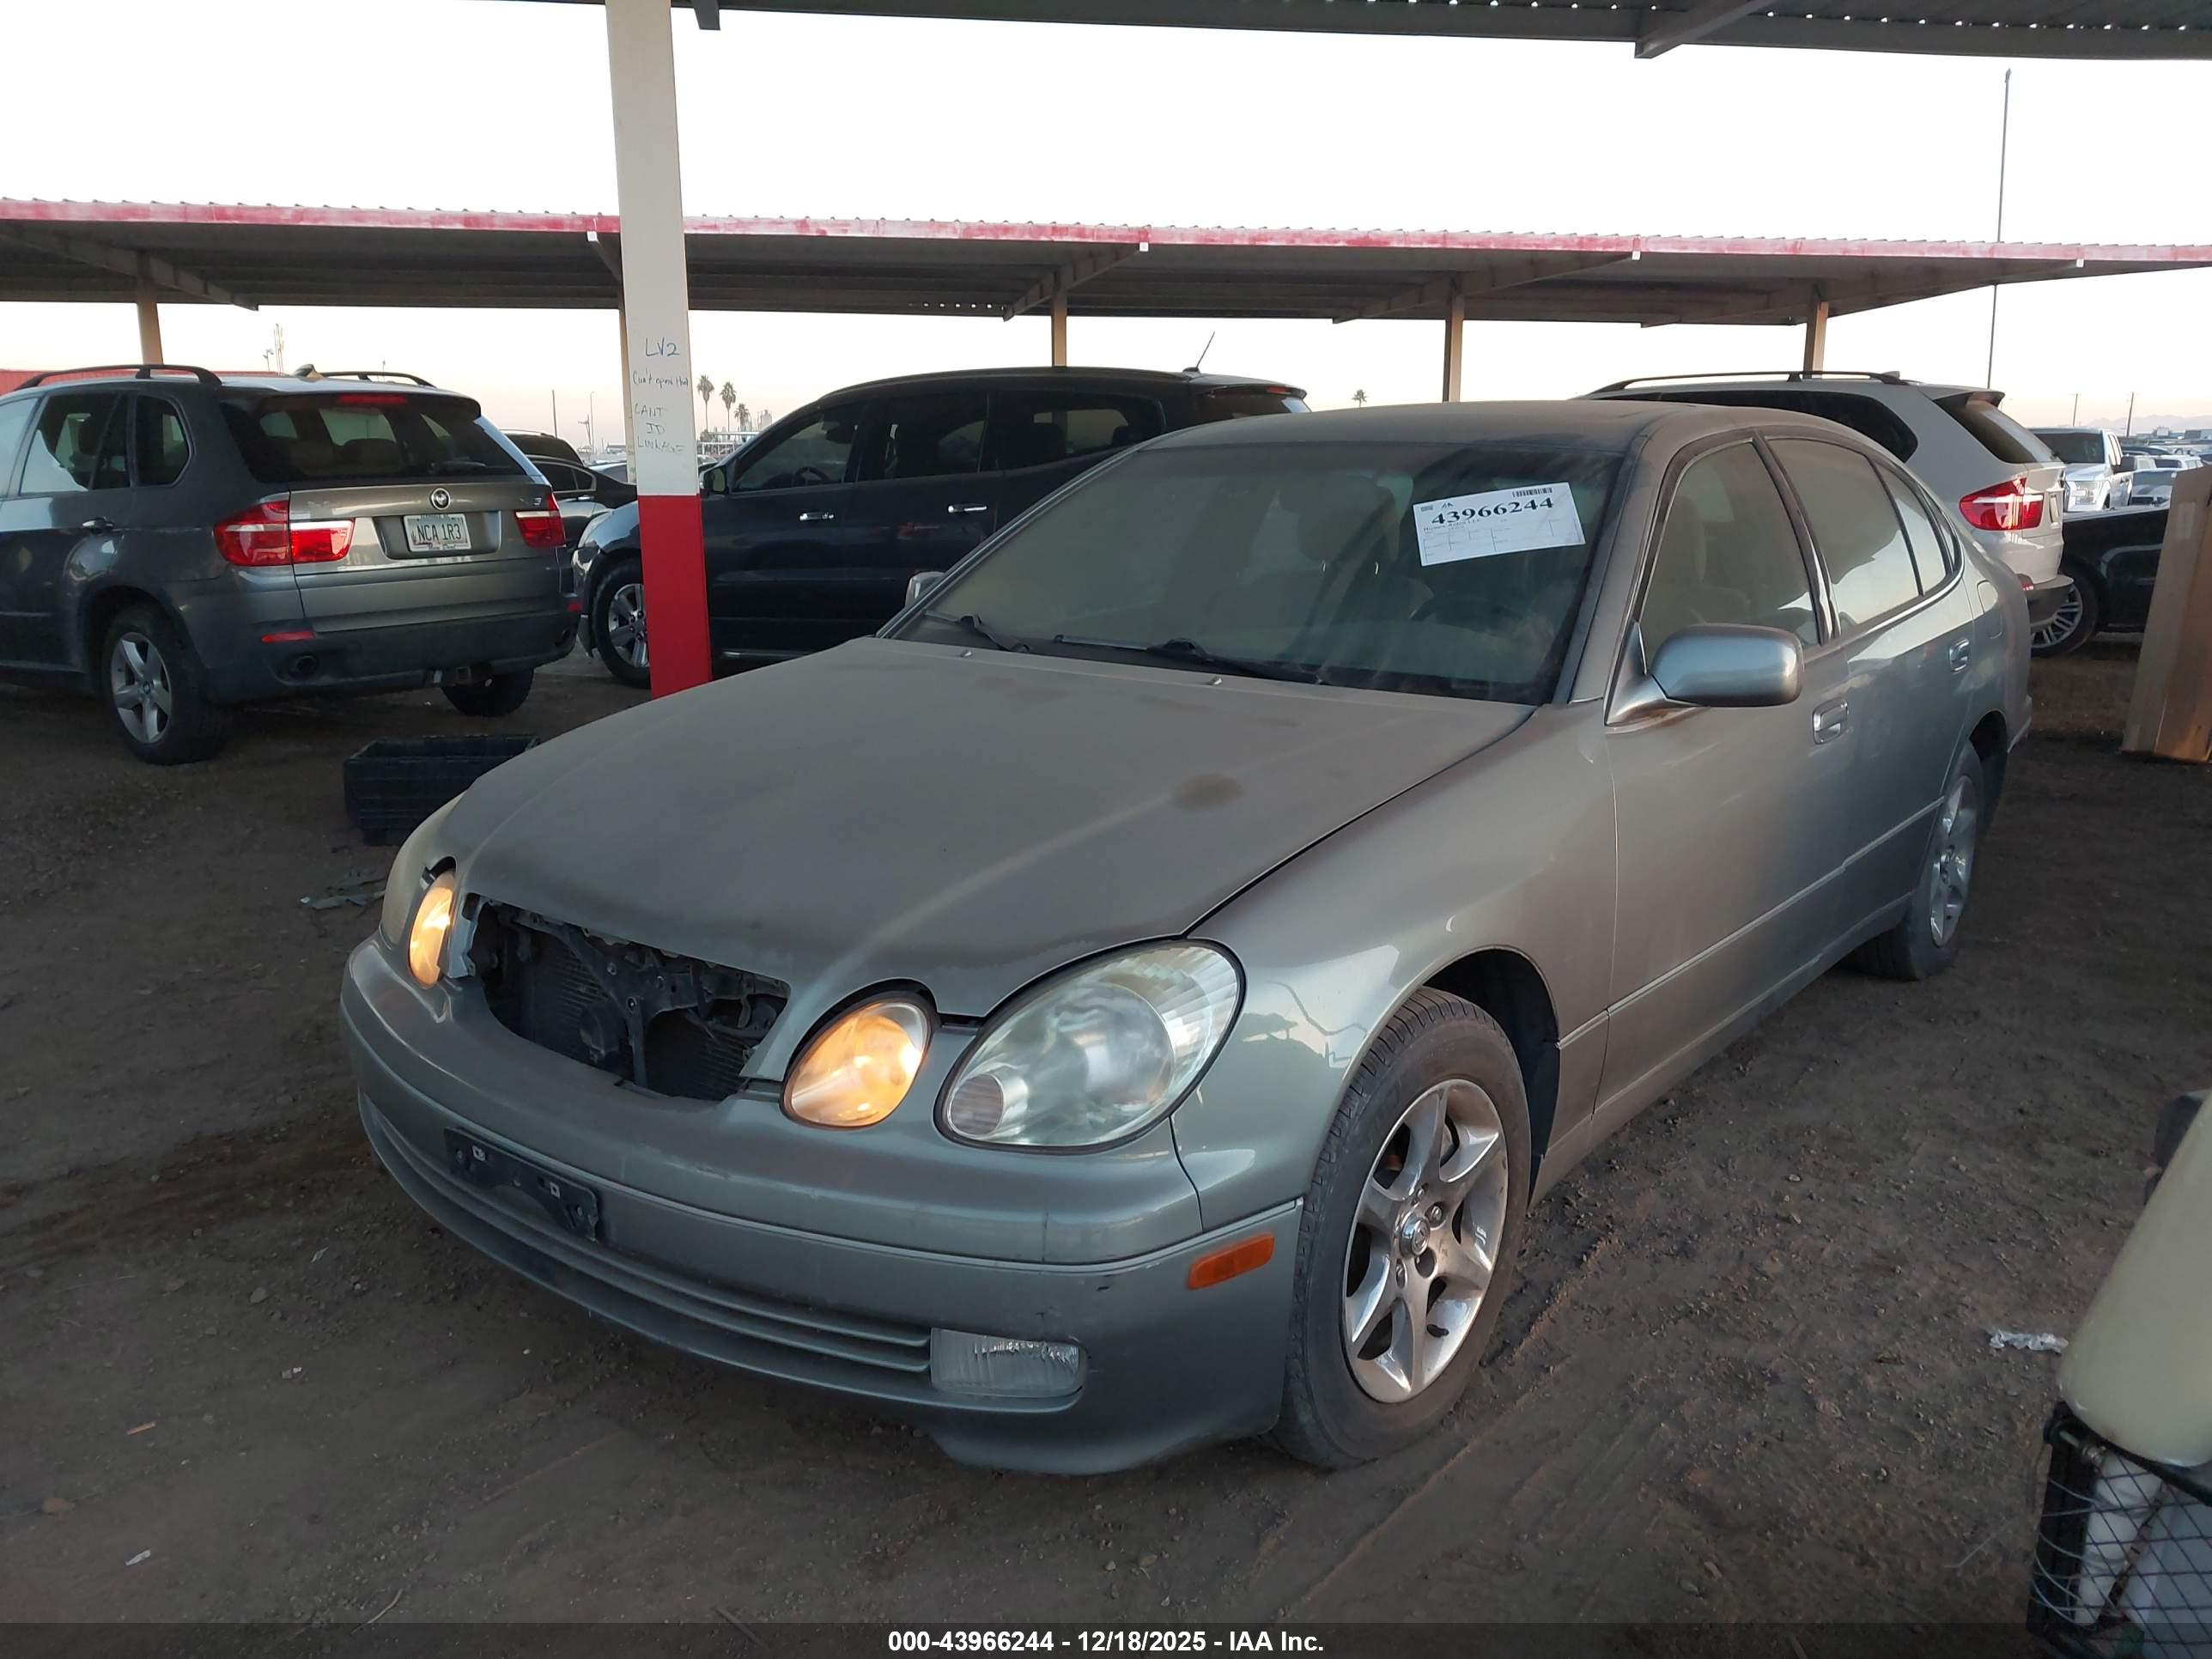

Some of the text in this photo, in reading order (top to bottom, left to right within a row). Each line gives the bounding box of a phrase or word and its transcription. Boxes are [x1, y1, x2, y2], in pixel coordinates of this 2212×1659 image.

[644, 336, 681, 357] LV2
[634, 402, 667, 418] CANT
[1431, 497, 1554, 525] 43966244
[416, 522, 462, 543] NCA 1R3
